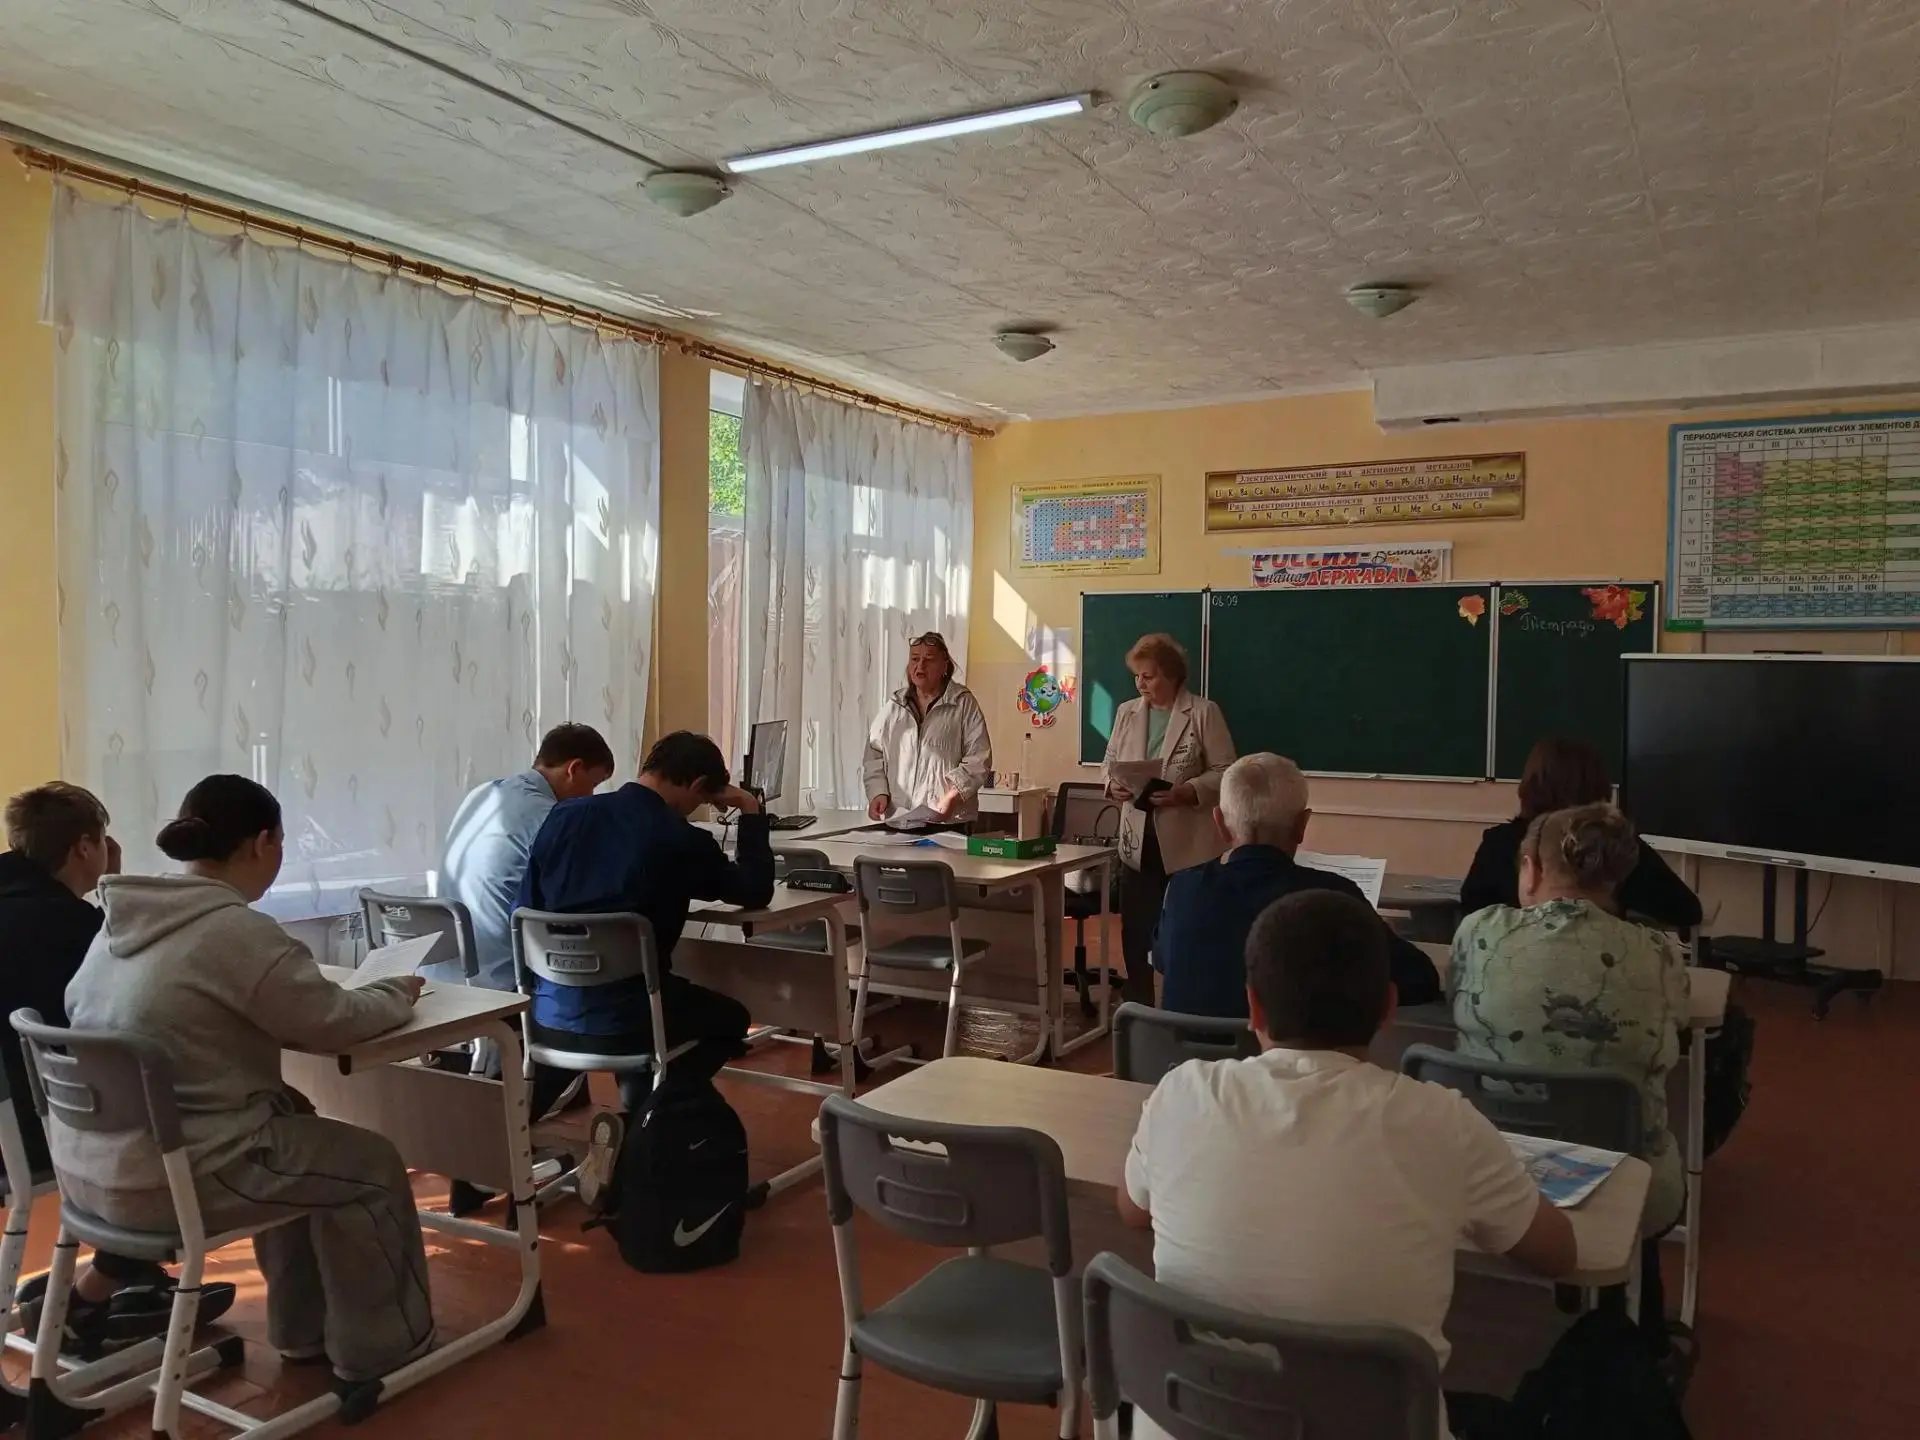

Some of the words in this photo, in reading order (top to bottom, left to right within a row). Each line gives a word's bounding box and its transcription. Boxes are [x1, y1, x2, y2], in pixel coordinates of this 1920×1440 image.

[1683, 430, 1754, 441] ПЕРИОДИЧЕСКАЯ
[1756, 427, 1796, 437] СИСТЕМА
[1798, 424, 1856, 434] ХИМИЧЕСКИХ
[1858, 421, 1911, 431] ЭЛЕМЕНТОВ
[1306, 566, 1406, 587] ДЕРЖАВА!
